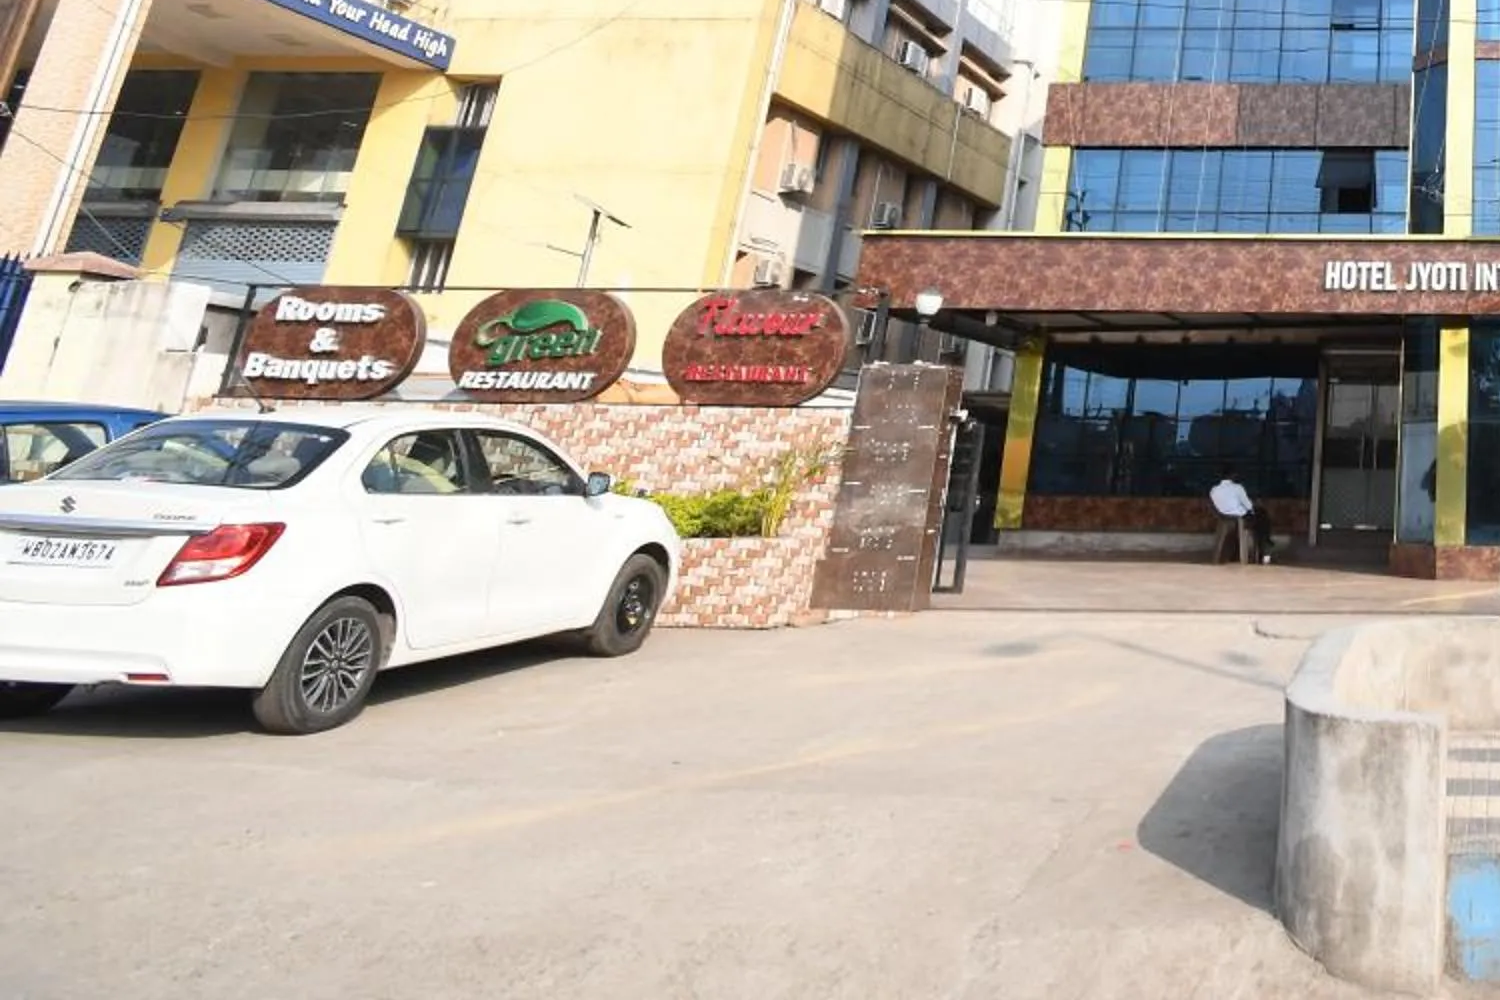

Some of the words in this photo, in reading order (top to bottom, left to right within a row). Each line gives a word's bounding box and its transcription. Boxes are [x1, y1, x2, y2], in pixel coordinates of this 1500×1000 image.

[369, 11, 412, 41] Head
[413, 29, 447, 58] High
[1325, 261, 1397, 290] HOTEL
[1405, 262, 1467, 291] JYOTI
[275, 296, 386, 322] Rooms
[310, 328, 340, 352] &
[485, 328, 602, 367] green
[242, 352, 397, 384] Banquets
[458, 371, 598, 389] RESTAURANT
